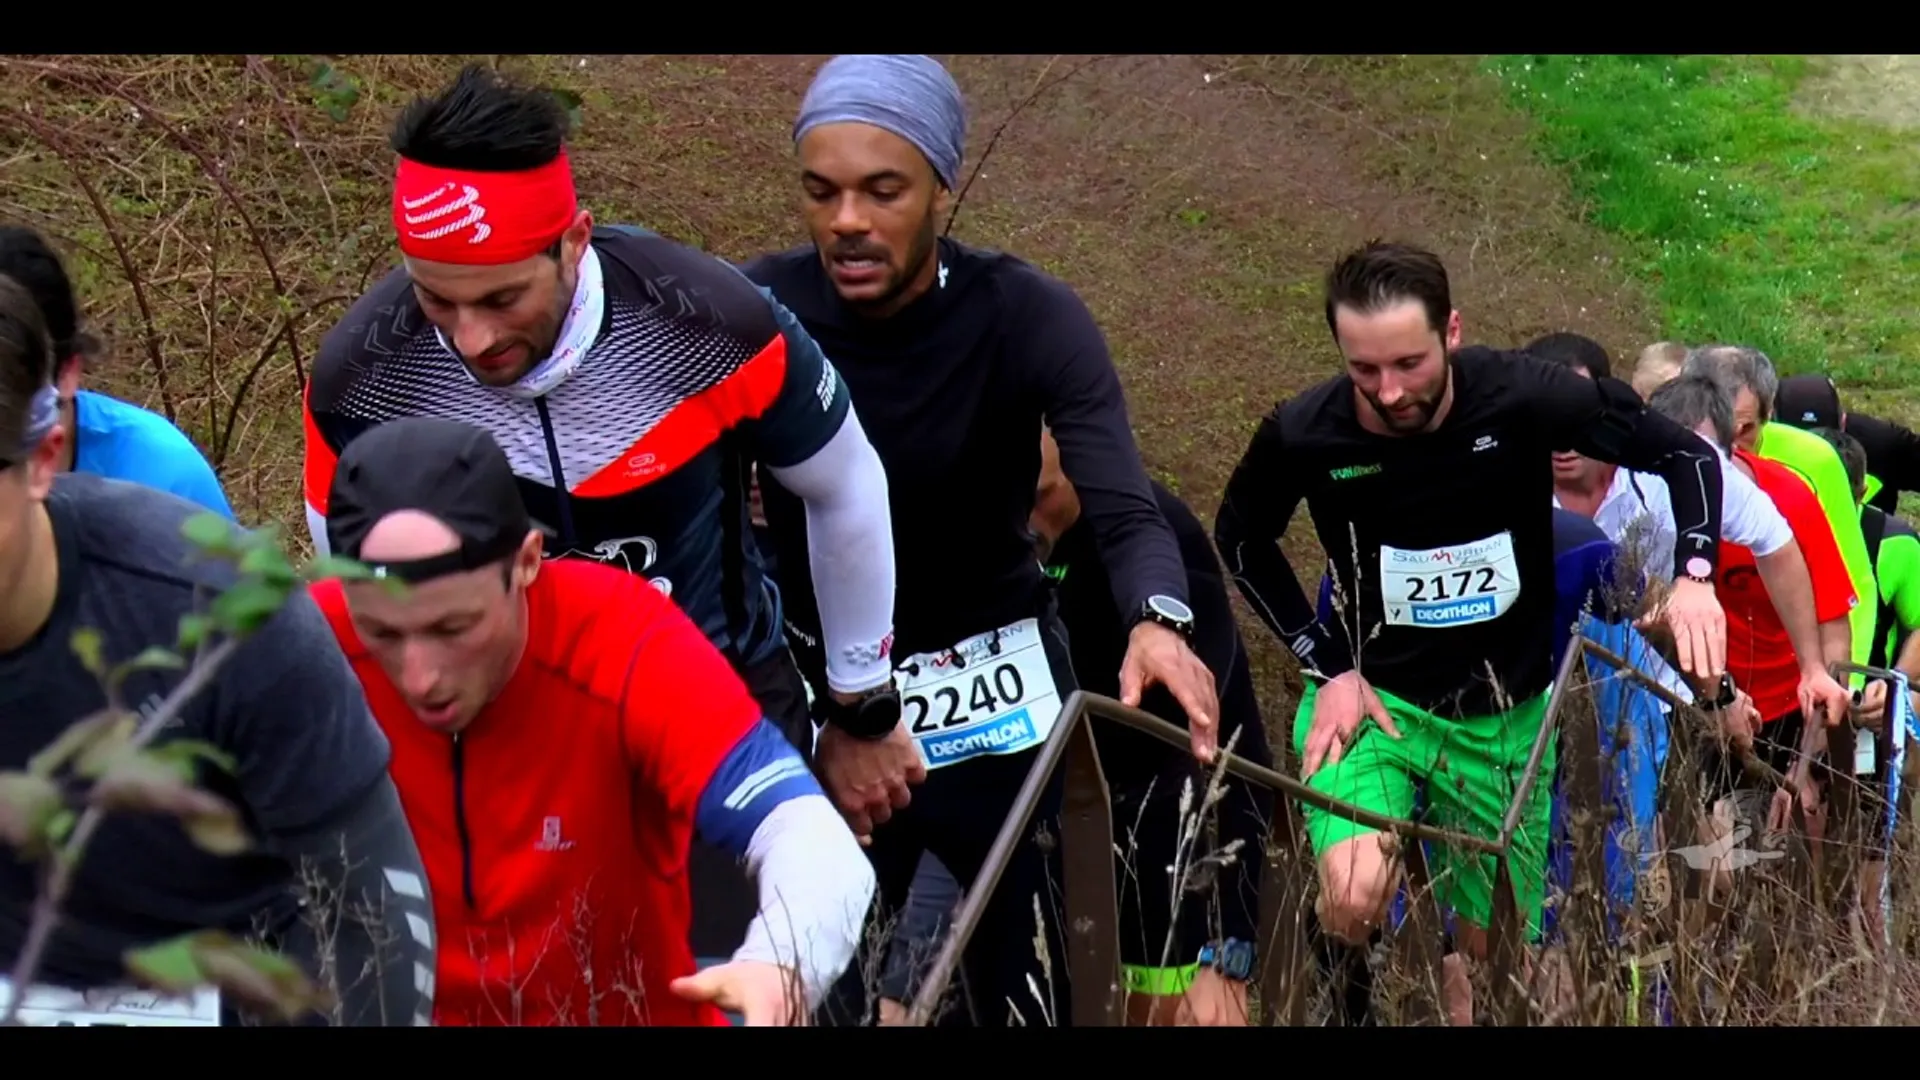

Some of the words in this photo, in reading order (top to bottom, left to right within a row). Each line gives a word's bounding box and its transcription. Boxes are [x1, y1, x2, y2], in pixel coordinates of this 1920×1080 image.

[1405, 567, 1497, 602] 2172
[1416, 601, 1491, 620] DECATHLON
[903, 662, 1024, 734] 2240
[928, 716, 1028, 758] DECATHLON
